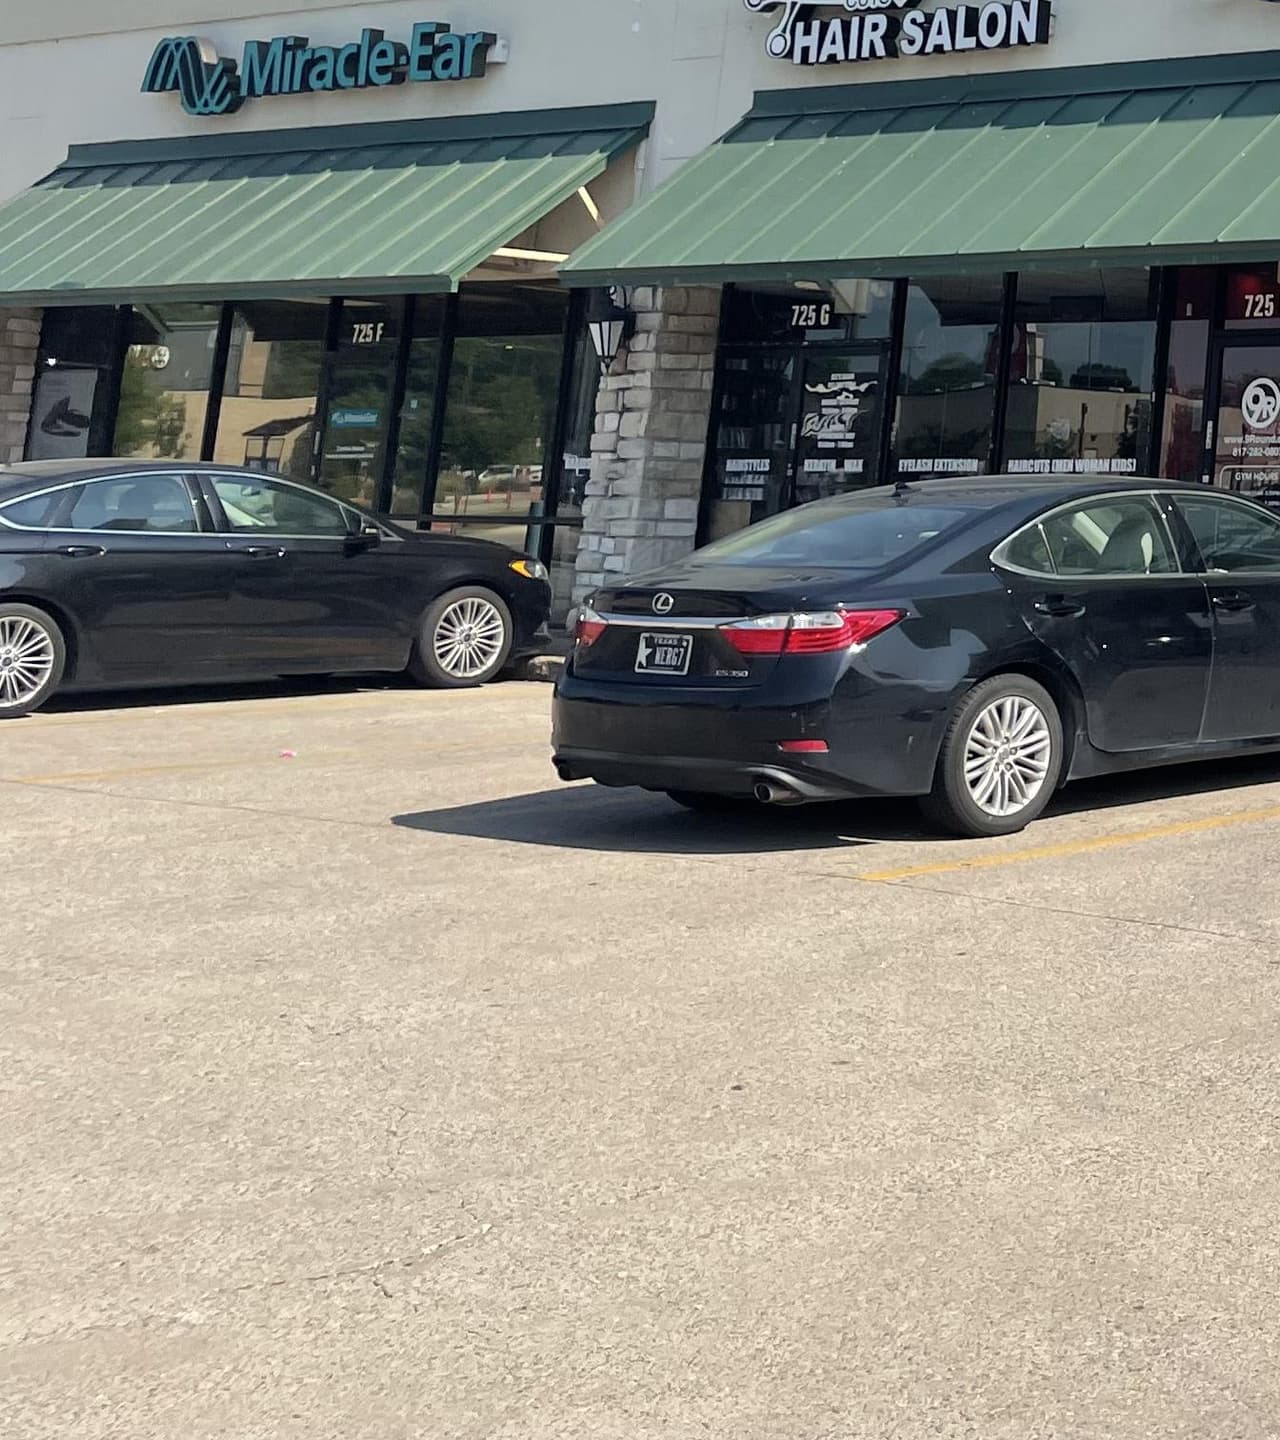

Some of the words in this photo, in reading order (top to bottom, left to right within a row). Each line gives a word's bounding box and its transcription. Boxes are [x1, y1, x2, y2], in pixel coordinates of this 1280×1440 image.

[792, 13, 890, 64] HAIR
[791, 305, 816, 326] 725
[820, 304, 830, 325] G
[1244, 294, 1275, 317] 725
[352, 323, 374, 343] 725
[375, 322, 384, 342] F
[899, 459, 934, 473] EYELASH
[1007, 459, 1050, 473] HAIRCUTS
[1235, 472, 1252, 480] GYM
[1253, 472, 1280, 481] HOURS
